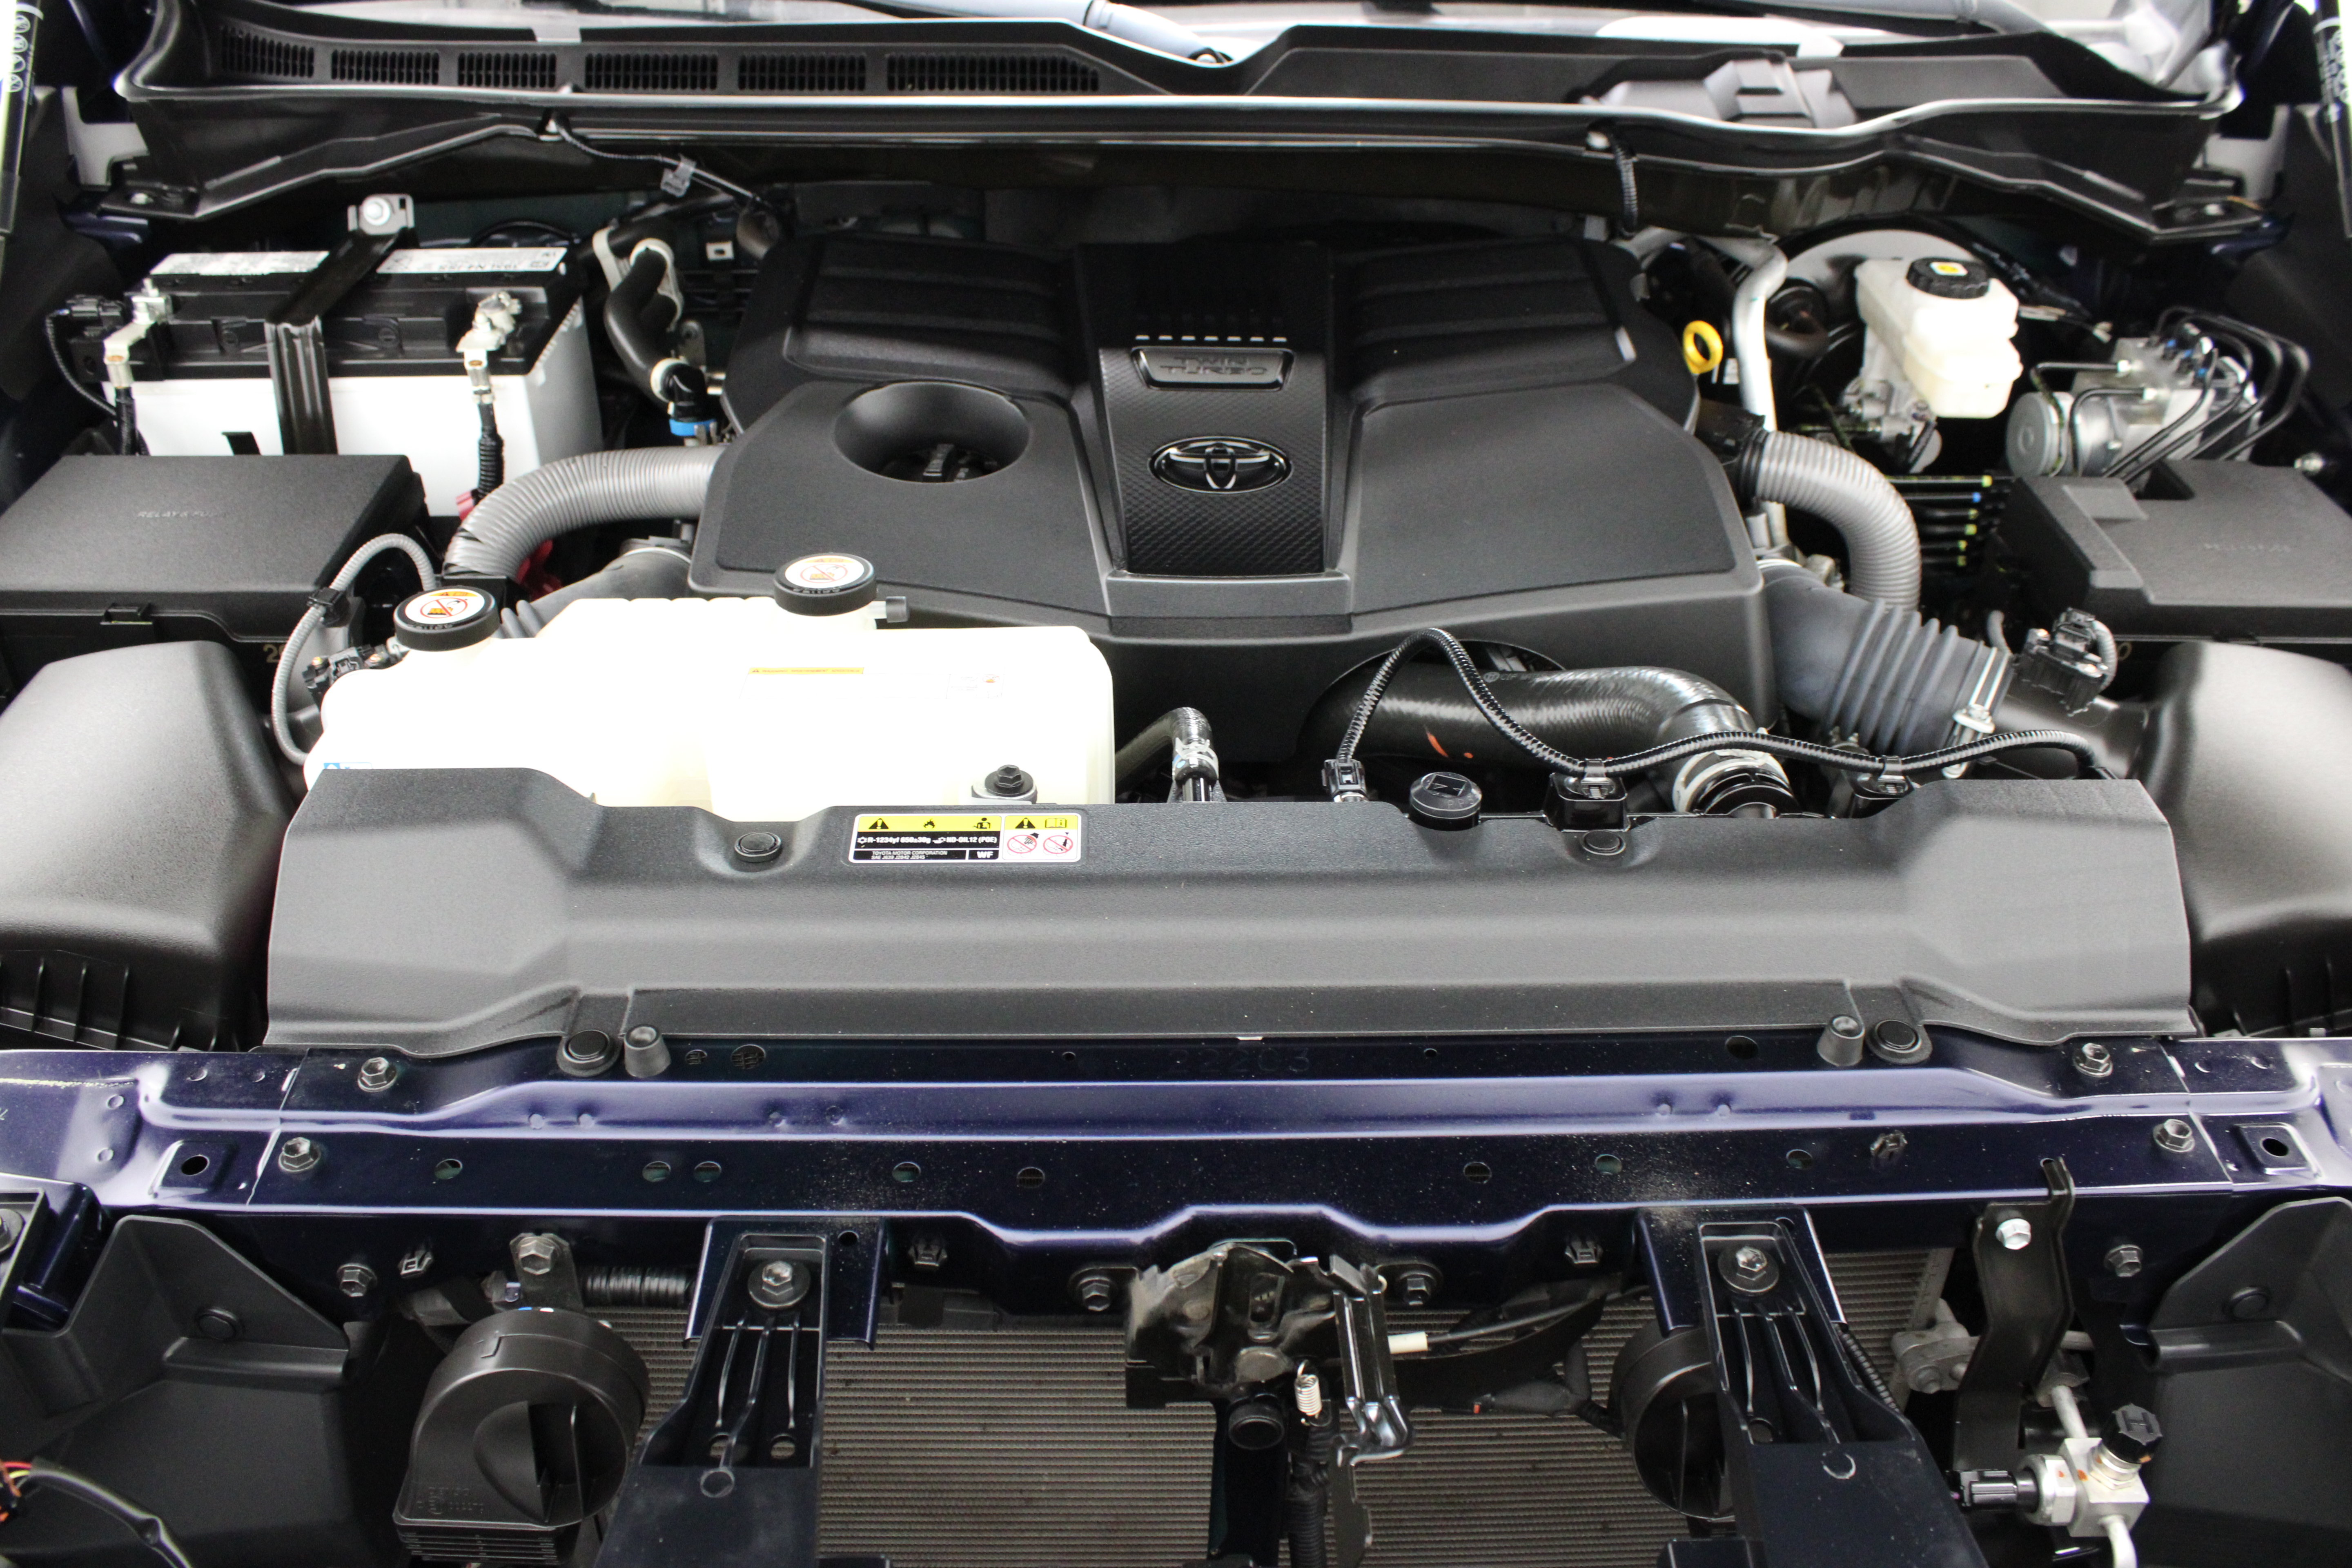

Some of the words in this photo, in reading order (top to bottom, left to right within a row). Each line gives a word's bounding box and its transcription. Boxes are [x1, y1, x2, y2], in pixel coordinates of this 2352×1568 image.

[1160, 365, 1267, 374] TURBO
[976, 851, 993, 859] WF
[2121, 1410, 2154, 1434] H
